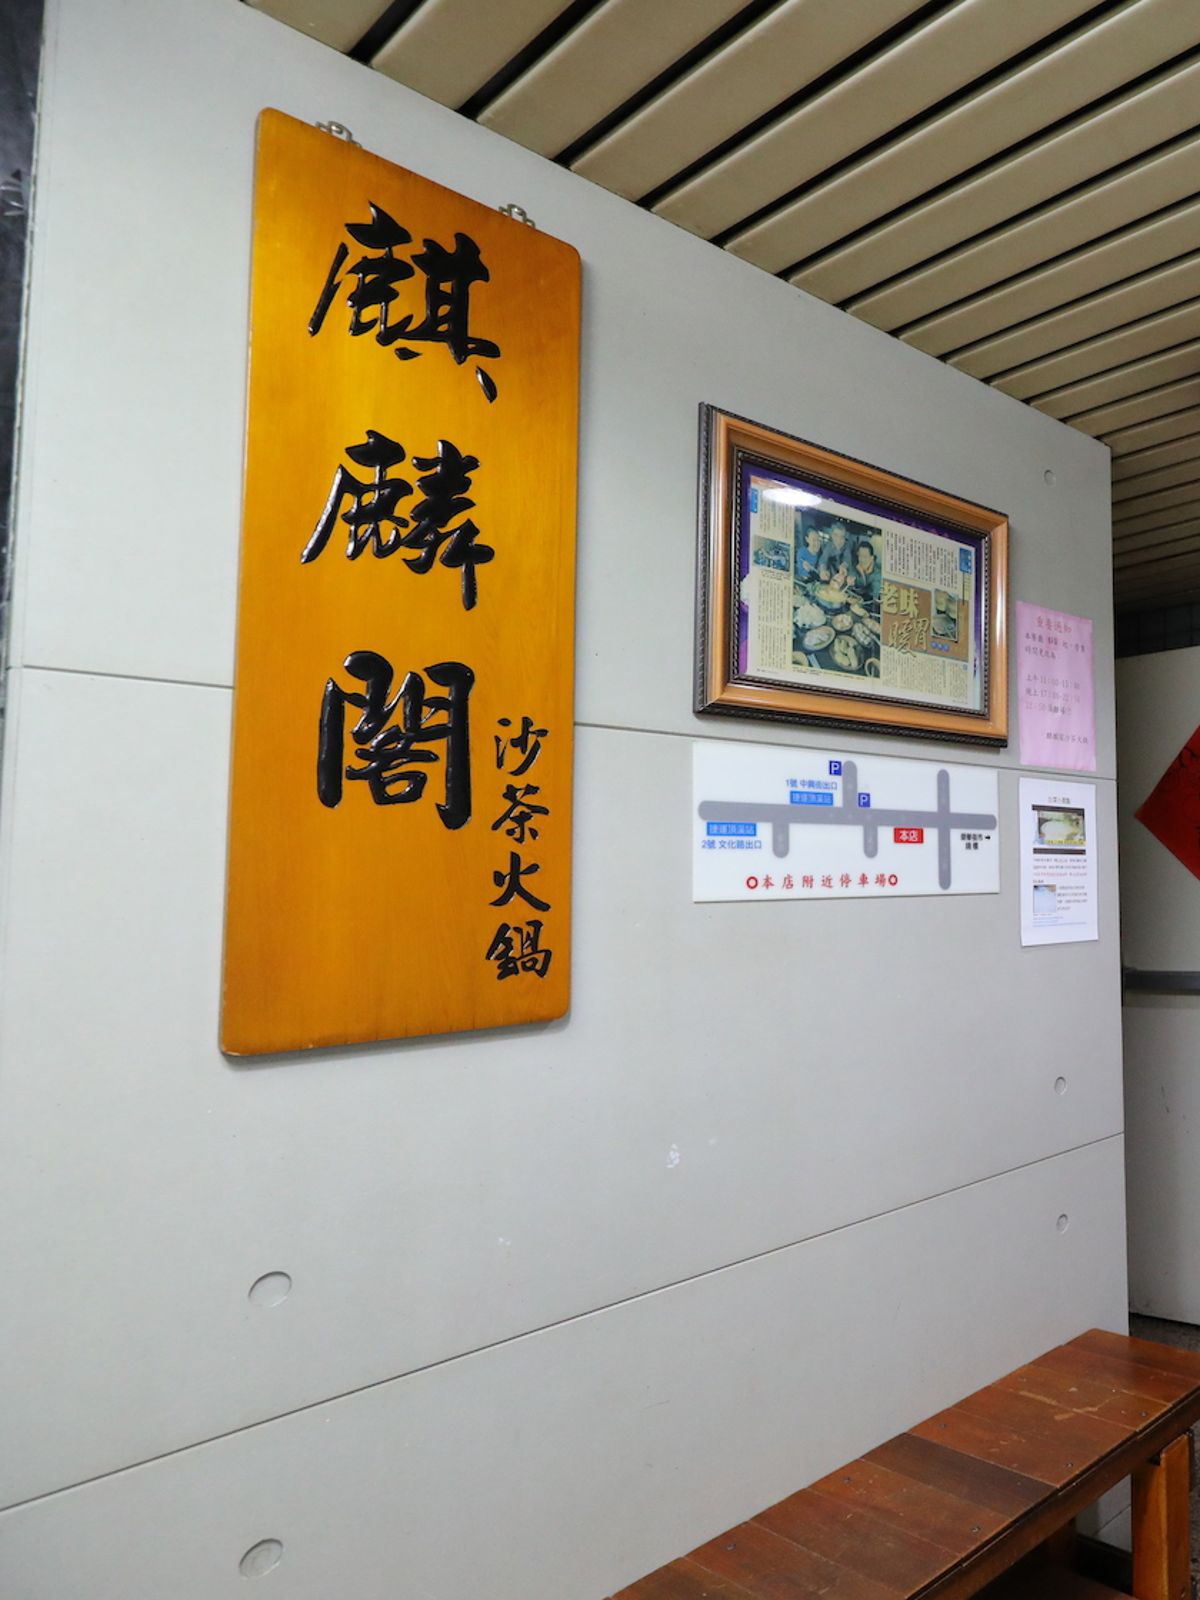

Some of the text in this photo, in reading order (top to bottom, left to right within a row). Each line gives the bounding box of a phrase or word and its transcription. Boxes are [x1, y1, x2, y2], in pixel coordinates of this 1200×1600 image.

[301, 202, 500, 831] 麒麟閣
[718, 840, 762, 850] 文化路出口
[899, 830, 919, 842] 本店
[485, 716, 552, 981] 沙茶火鍋
[761, 872, 887, 891] 本店附近停車場
